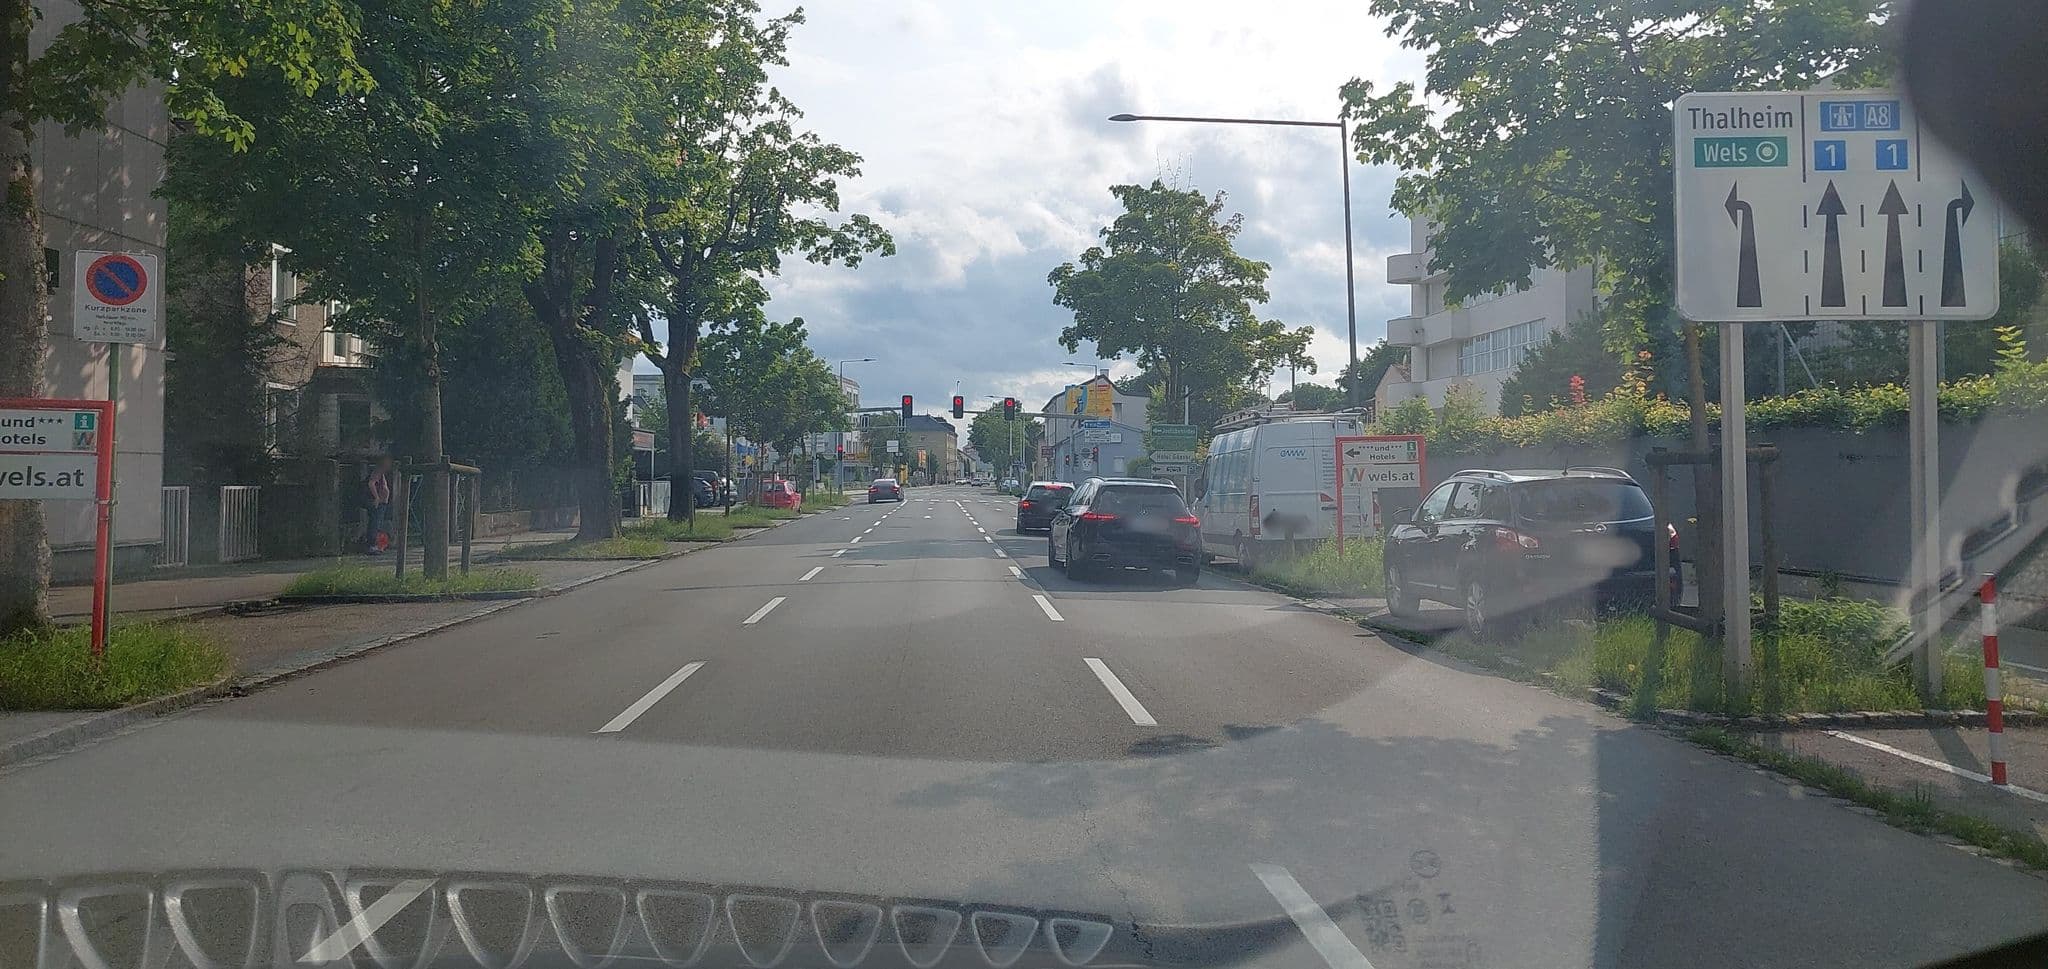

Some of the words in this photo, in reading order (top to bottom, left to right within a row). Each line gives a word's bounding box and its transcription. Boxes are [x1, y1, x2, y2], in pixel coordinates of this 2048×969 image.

[1688, 105, 1793, 130] Thalheim
[1866, 106, 1889, 126] A8
[1703, 143, 1748, 163] Wels
[1824, 144, 1837, 167] 1
[1887, 143, 1899, 166] 1
[84, 304, 147, 314] Kurzparkzone
[1, 433, 47, 445] otels
[1369, 453, 1396, 461] Hotels
[1368, 470, 1415, 482] wels.at
